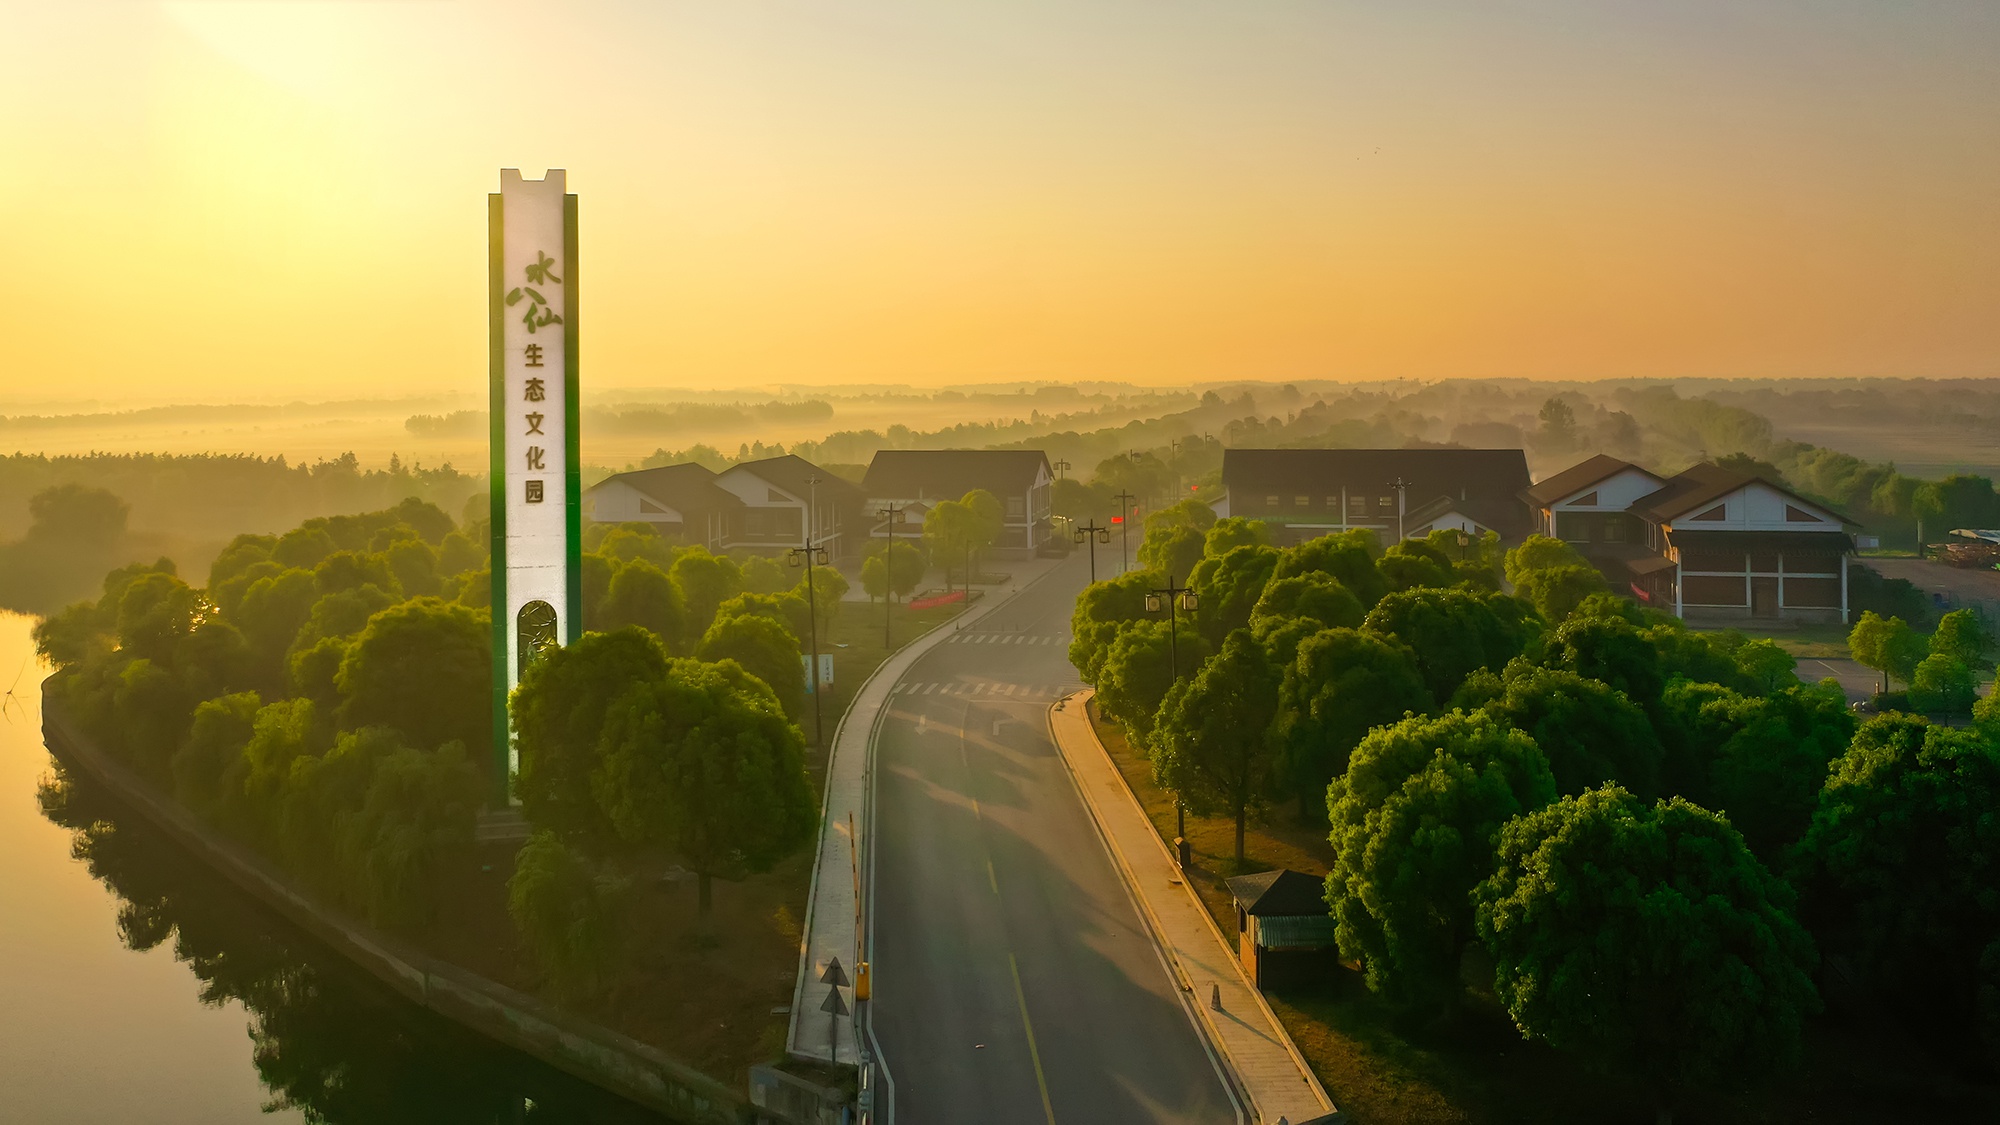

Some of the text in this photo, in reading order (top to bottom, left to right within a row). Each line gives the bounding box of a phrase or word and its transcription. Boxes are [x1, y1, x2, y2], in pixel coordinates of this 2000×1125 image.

[505, 250, 563, 333] 水八仙
[524, 343, 546, 504] 生态文化园
